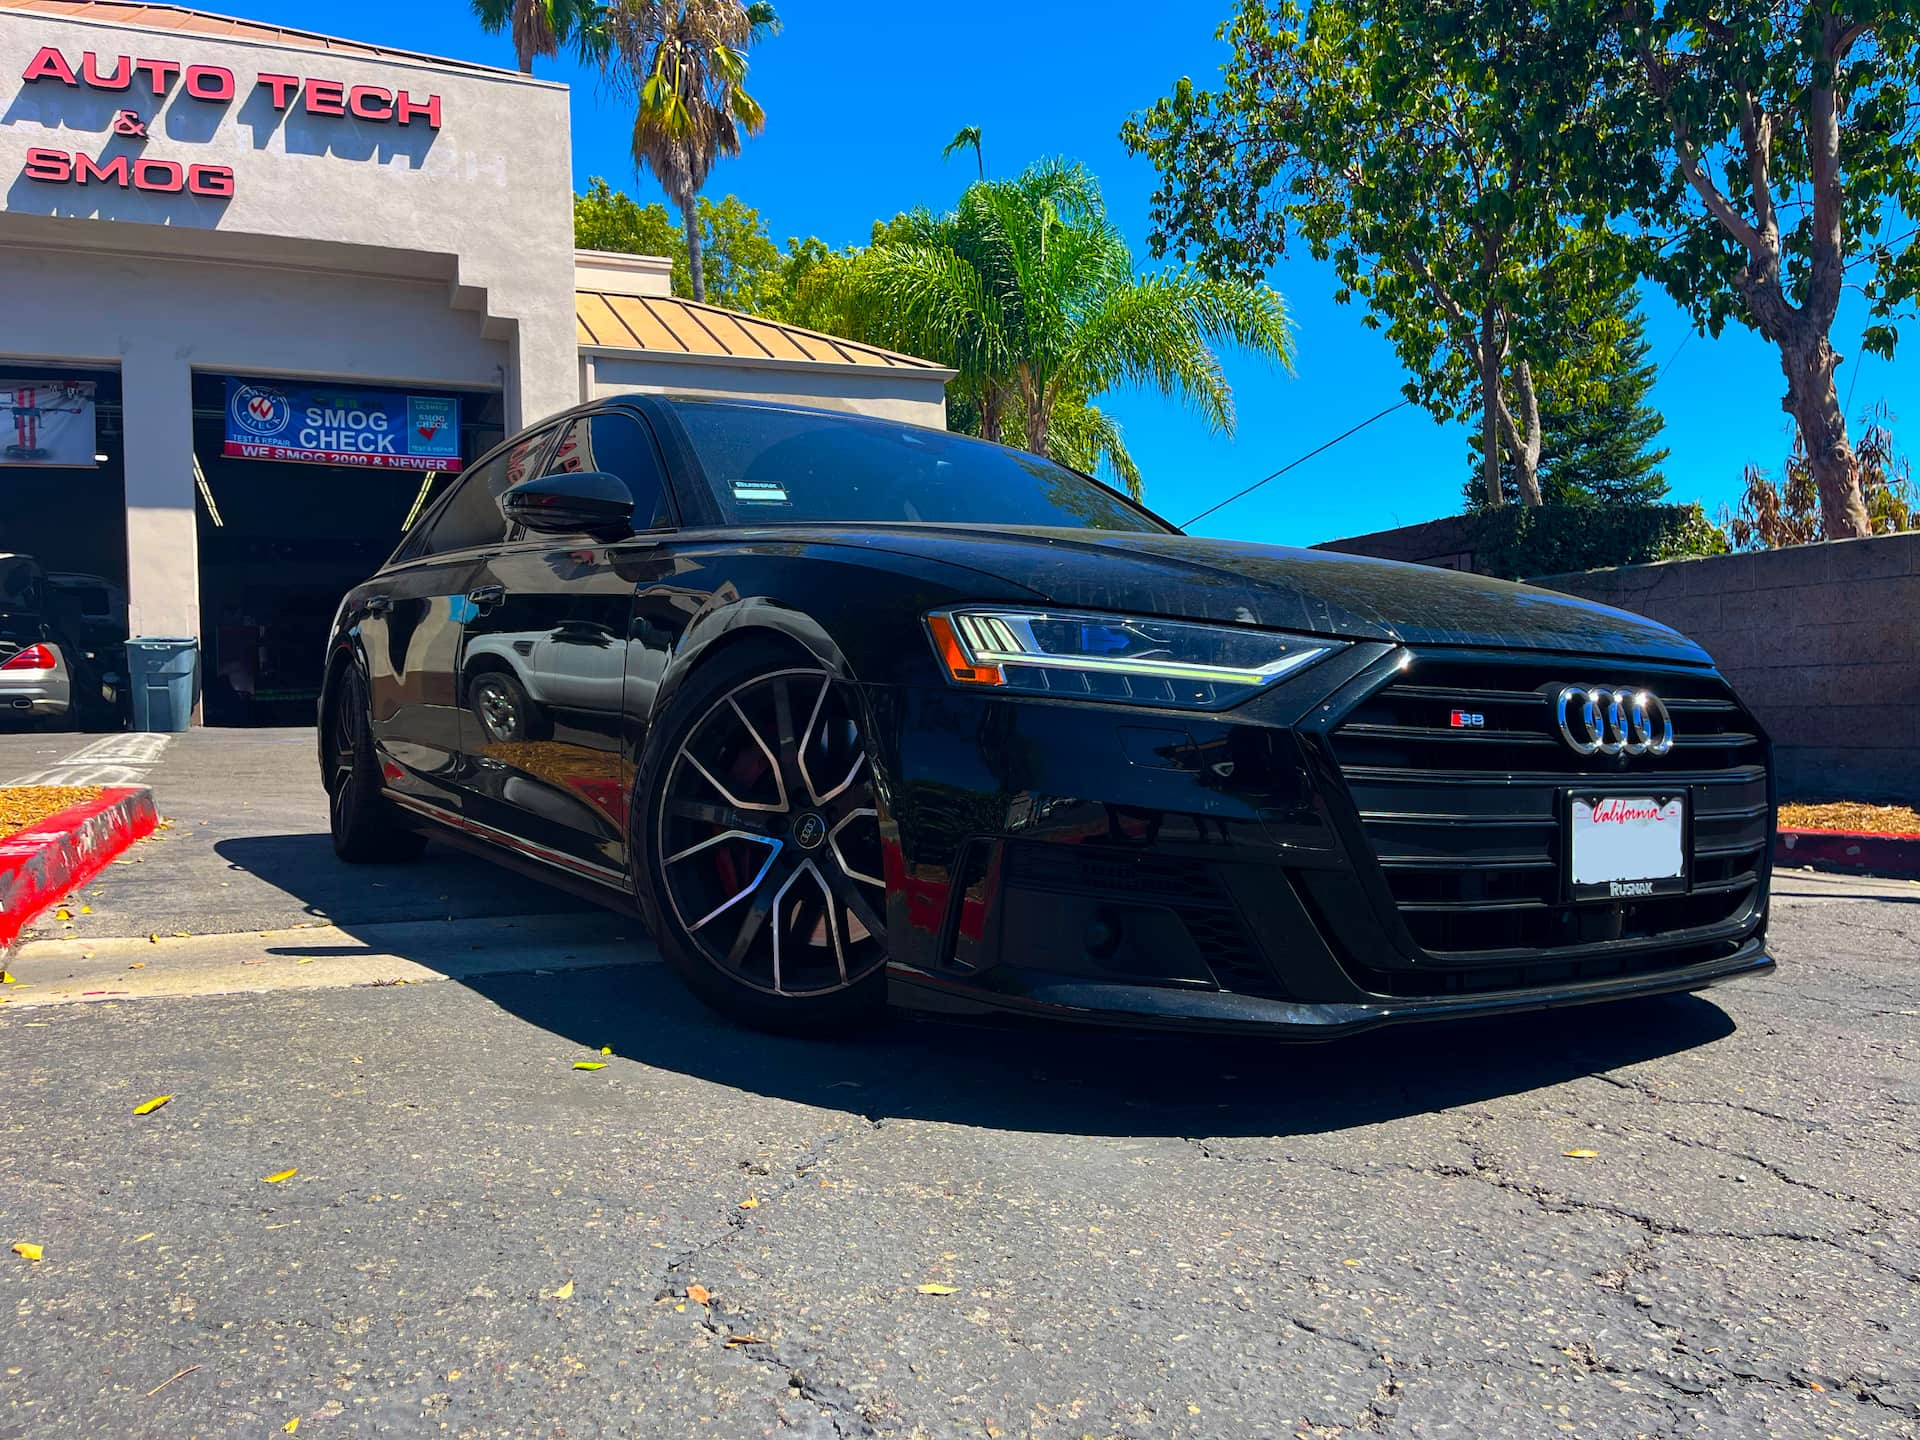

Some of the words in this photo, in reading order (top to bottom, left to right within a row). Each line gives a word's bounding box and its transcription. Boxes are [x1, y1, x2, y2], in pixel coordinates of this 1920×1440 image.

[22, 46, 235, 102] AUTO
[258, 72, 442, 129] TECH
[114, 110, 147, 138] &
[25, 147, 235, 198] SMOG
[305, 407, 388, 431] SMOG
[232, 434, 252, 443] TEST
[262, 437, 290, 447] REPAIR
[299, 428, 396, 453] CHECK
[241, 445, 269, 457] WE
[274, 447, 327, 462] SMOG
[330, 454, 368, 465] 2000
[372, 456, 384, 465] &
[388, 457, 448, 470] NEWER
[1592, 800, 1664, 825] California
[1610, 882, 1653, 897] RUSNAK
